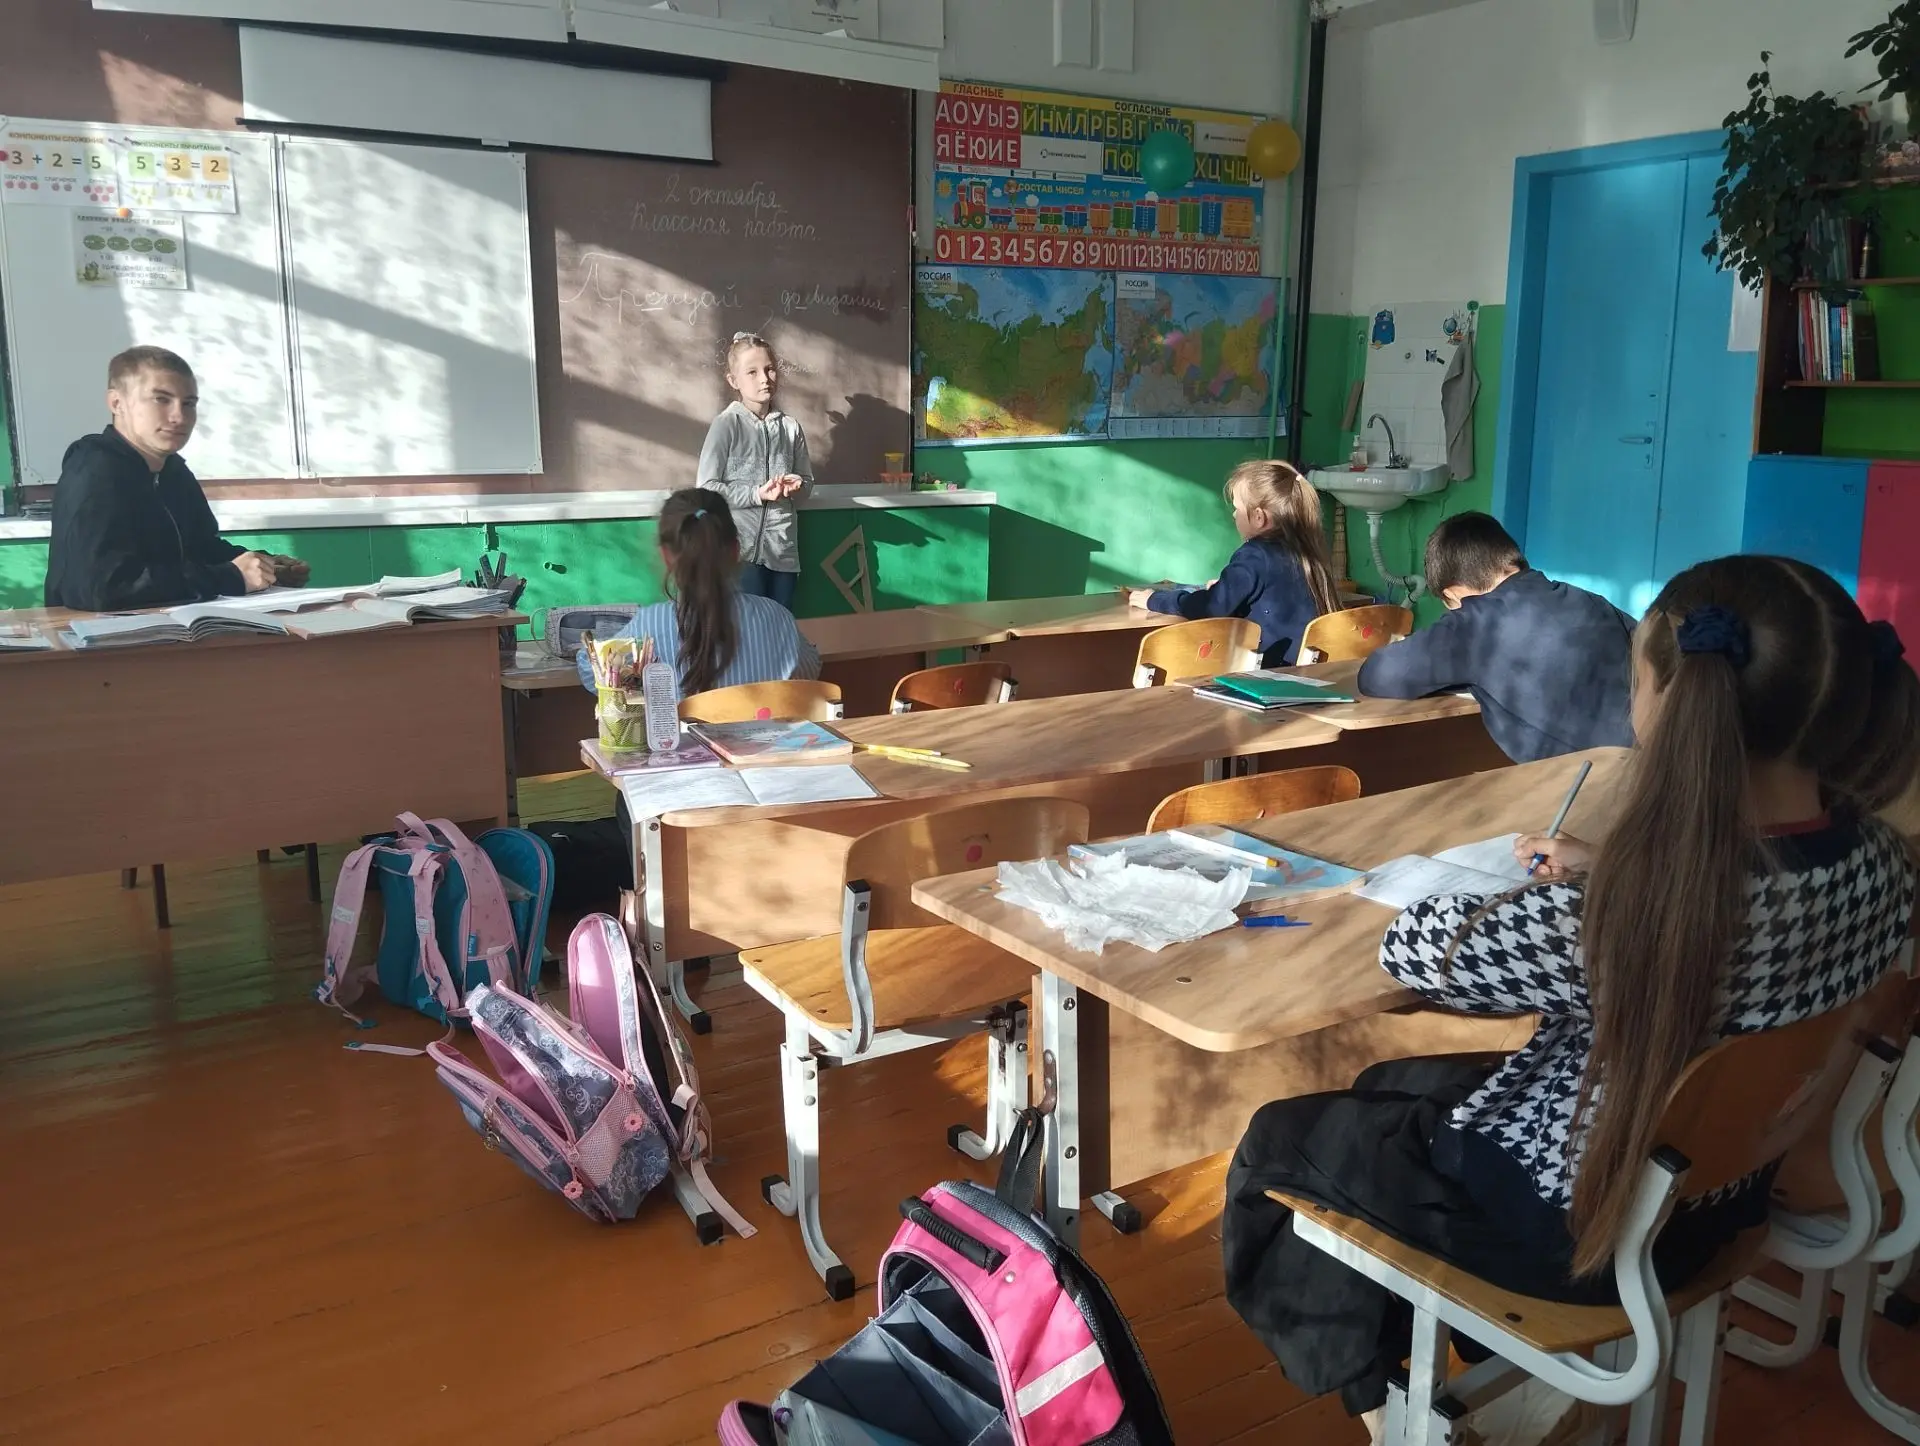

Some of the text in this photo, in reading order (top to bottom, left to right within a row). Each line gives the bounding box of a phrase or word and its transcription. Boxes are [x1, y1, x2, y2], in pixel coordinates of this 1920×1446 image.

[954, 84, 1004, 98] ГЛАСНЫЕ
[1114, 102, 1171, 116] СОГЛАСНЫЕ
[12, 150, 23, 165] 3
[52, 153, 63, 167] 2
[91, 156, 101, 169] 5
[136, 156, 146, 170] 5
[171, 157, 181, 171] 3
[210, 160, 220, 173] 2
[664, 174, 680, 203] 2
[1019, 184, 1052, 193] СОСТАВ
[1056, 186, 1084, 195] ЧИСЕЛ
[630, 200, 731, 235] Классная
[937, 235, 1259, 272] 0 1 2 3 4 5 6 7 8 9 10 11 12 13 14 15 16 17 18 19 20
[918, 271, 952, 281] РОССИЯ
[1125, 280, 1149, 288] РОССИЯ
[560, 252, 746, 324] Прощай
